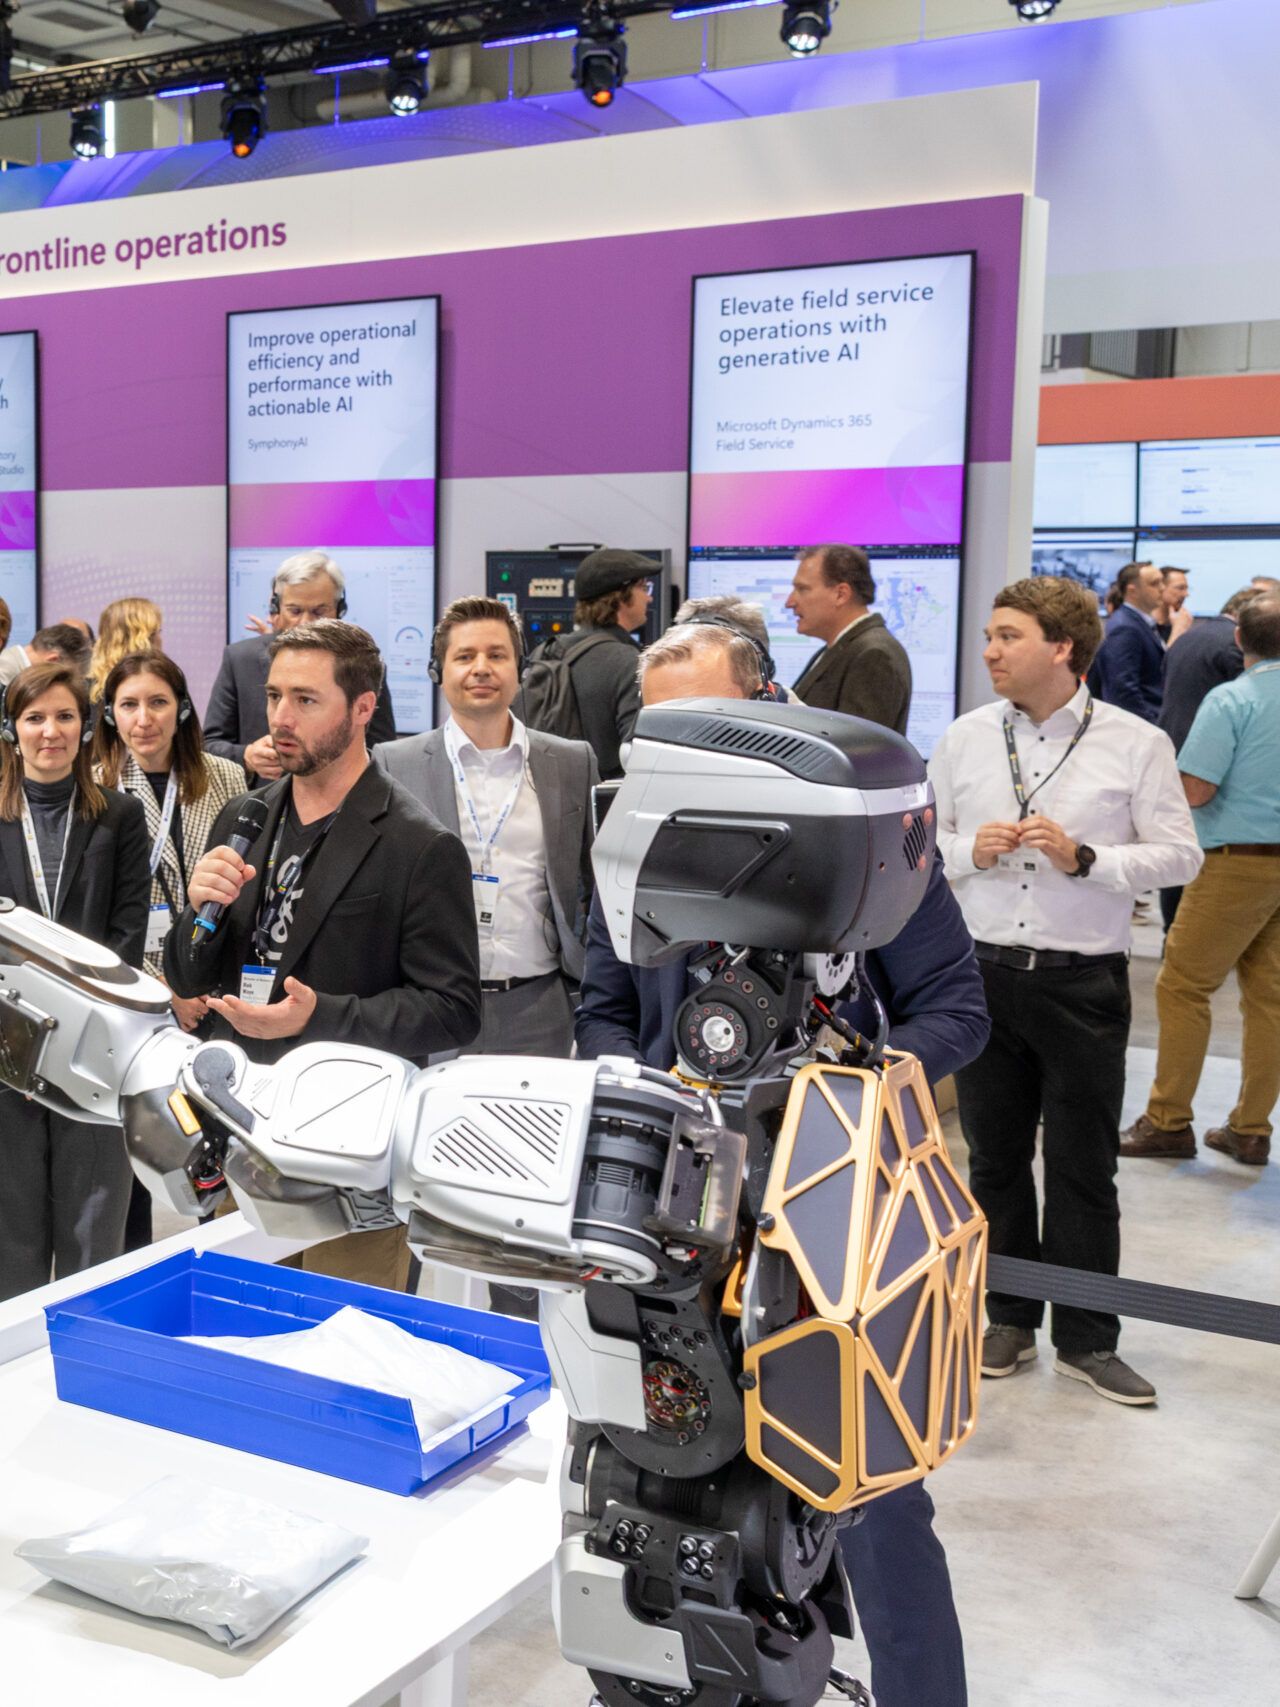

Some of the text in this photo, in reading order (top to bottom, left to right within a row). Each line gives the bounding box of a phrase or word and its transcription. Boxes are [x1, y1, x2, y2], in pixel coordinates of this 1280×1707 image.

[114, 218, 288, 270] operations
[721, 283, 934, 317] Elevate field service
[248, 319, 417, 351] Improve operational
[719, 312, 887, 347] operations with
[248, 347, 360, 372] efficiency and
[718, 342, 860, 375] generative AI
[248, 369, 393, 399] performance with
[247, 396, 353, 417] actionable AI
[715, 414, 873, 434] Microsoft Dynamics 365
[247, 436, 309, 453] SymphonyAI
[715, 436, 795, 452] Field Service
